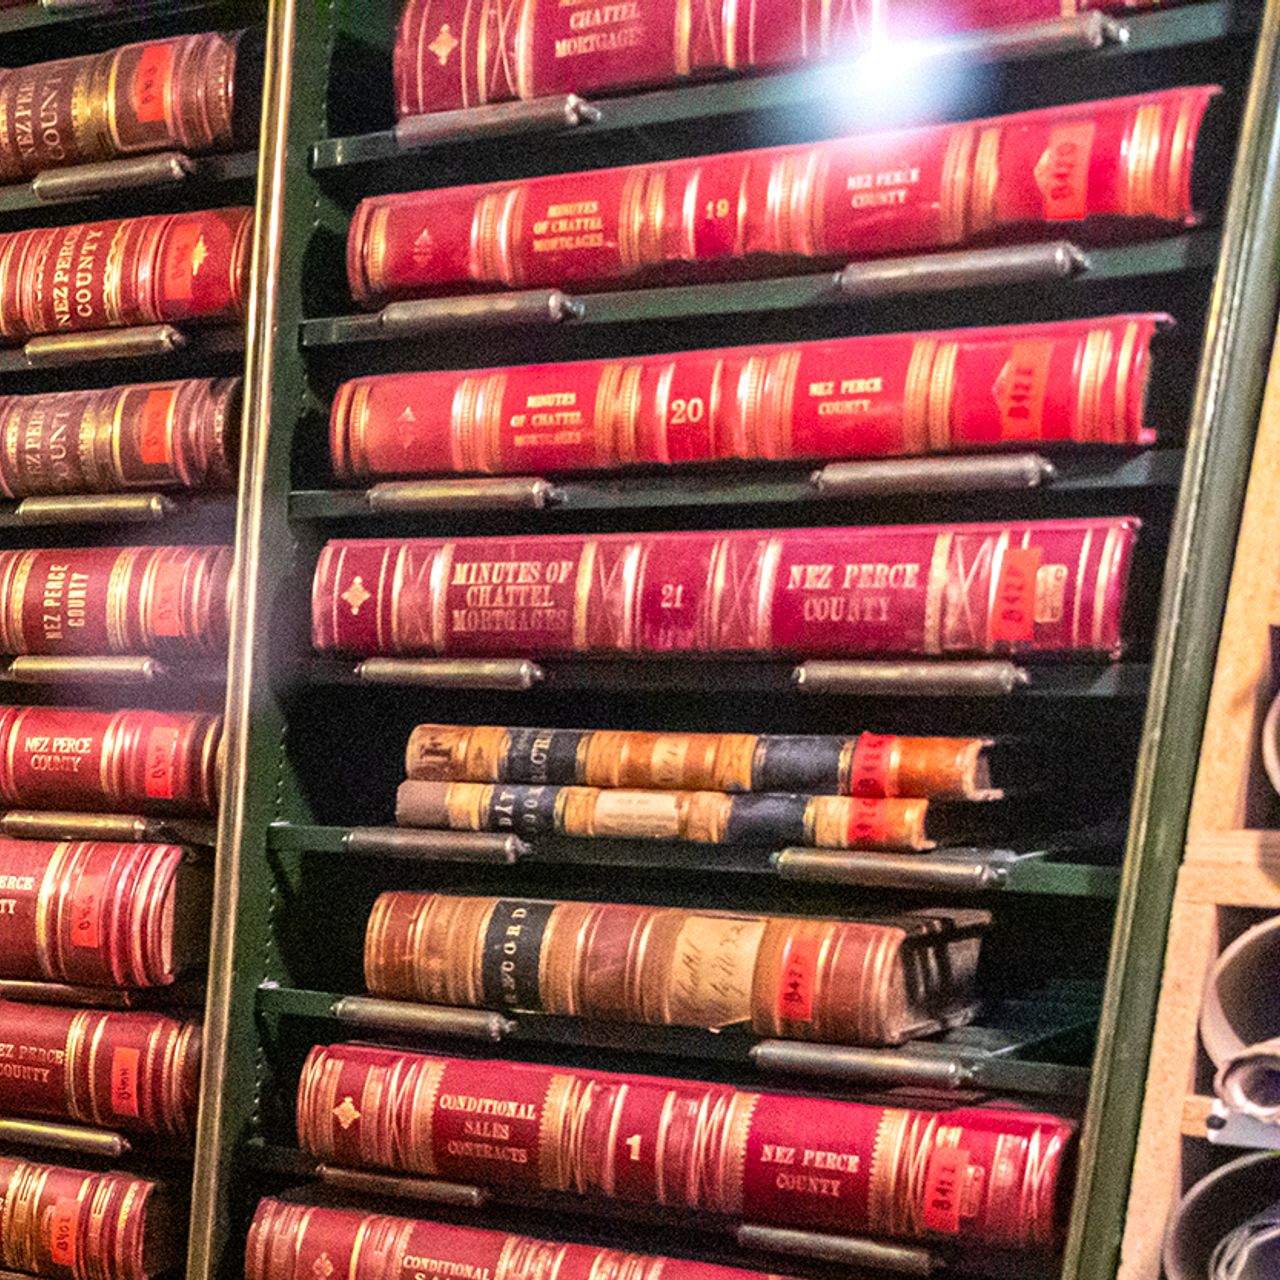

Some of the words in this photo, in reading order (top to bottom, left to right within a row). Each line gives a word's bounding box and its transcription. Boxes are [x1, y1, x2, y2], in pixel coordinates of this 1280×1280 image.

[547, 201, 598, 219] MINUTES
[705, 199, 730, 222] 19
[851, 188, 907, 209] COUNTY
[532, 221, 551, 235] OF
[554, 215, 604, 233] CHATTEL
[76, 228, 103, 318] COUNTY
[808, 381, 835, 397] NEZ
[839, 377, 883, 396] PERCE
[526, 393, 576, 409] MINUTES
[671, 398, 704, 424] 20
[818, 398, 869, 417] COUNTY
[451, 563, 534, 587] MINUTES
[543, 561, 571, 583] OF
[787, 566, 836, 591] NEZ
[844, 562, 919, 590] PERCE
[68, 572, 89, 628] COUNTY
[465, 583, 554, 609] CHATTEL
[660, 583, 685, 608] 21
[452, 608, 568, 634] MORTGAGES
[802, 595, 891, 624] COUNTY
[24, 736, 50, 753] NEZ
[52, 737, 91, 755] PERCE
[30, 754, 82, 773] COUNTY
[18, 1046, 64, 1066] PERCE
[439, 1093, 537, 1121] CONDITIONAL
[464, 1121, 509, 1139] SALES
[446, 1142, 529, 1163] CONTRACTS
[624, 1133, 641, 1161] 1
[760, 1144, 797, 1166] NEZ
[802, 1149, 860, 1174] PERCE
[776, 1172, 842, 1198] COUNTY
